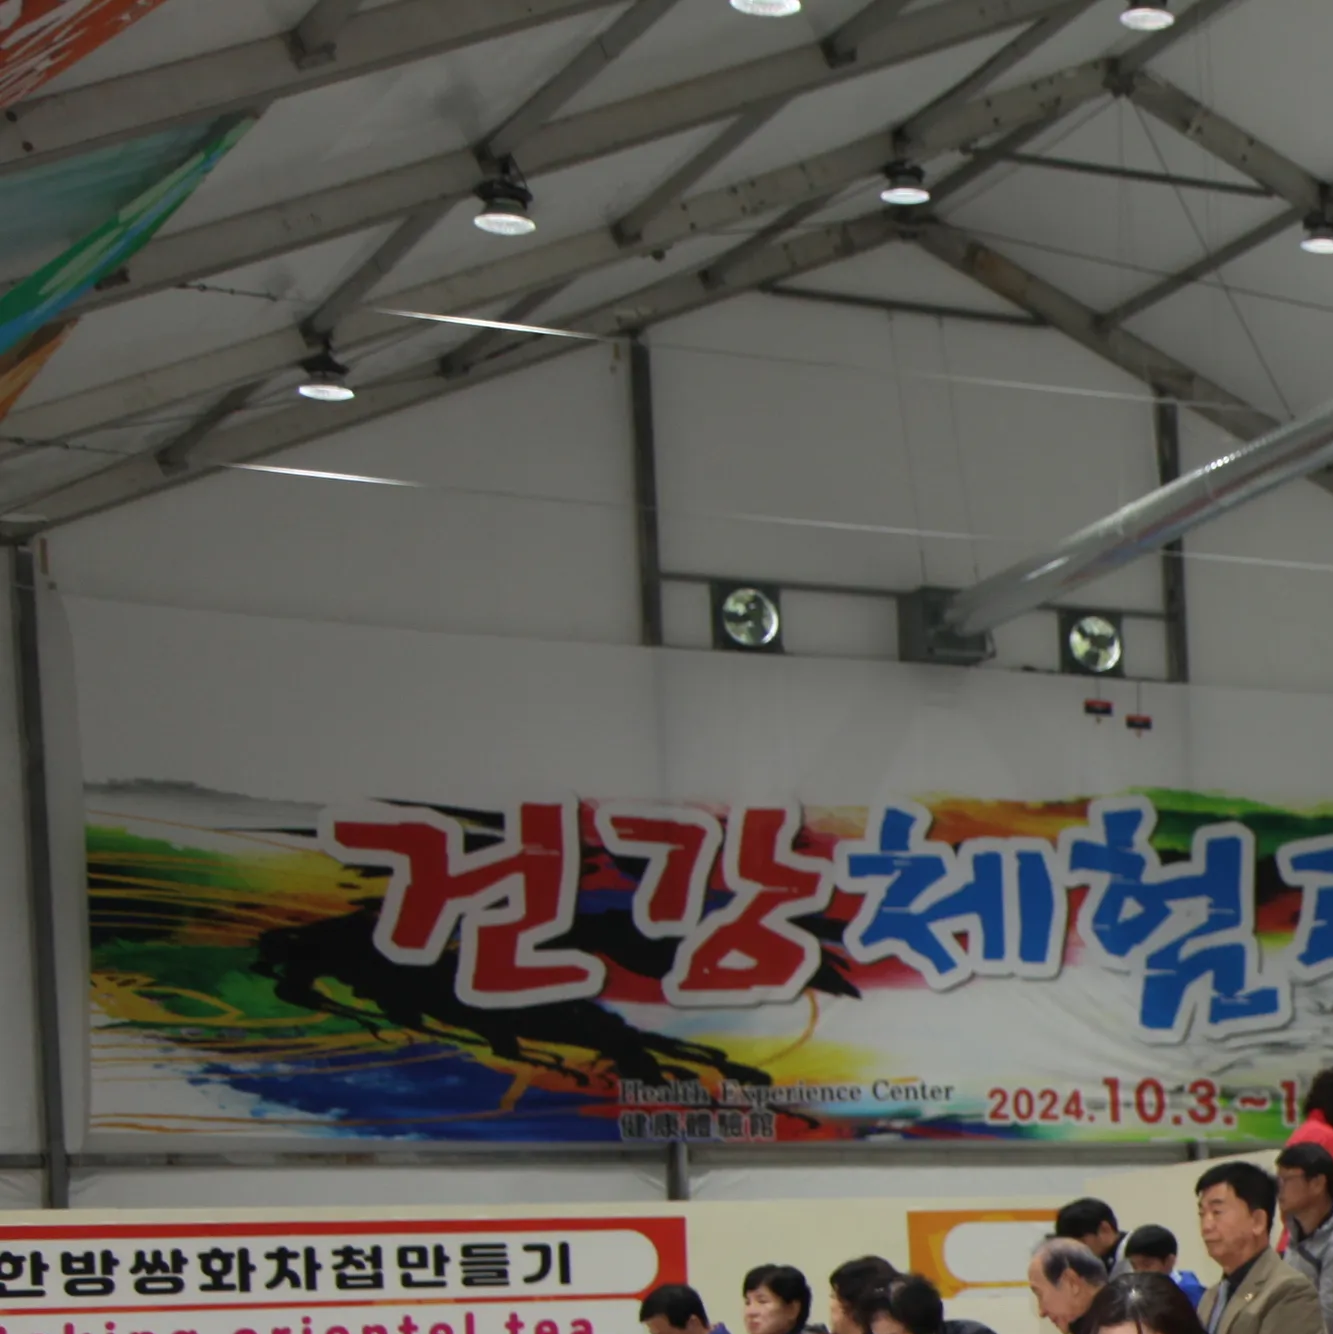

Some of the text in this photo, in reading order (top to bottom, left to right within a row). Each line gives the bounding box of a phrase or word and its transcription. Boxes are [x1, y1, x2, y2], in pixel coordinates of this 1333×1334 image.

[618, 1078, 955, 1107] Health Experience Center
[0, 1241, 573, 1298] 한방쌍화차첩만들기
